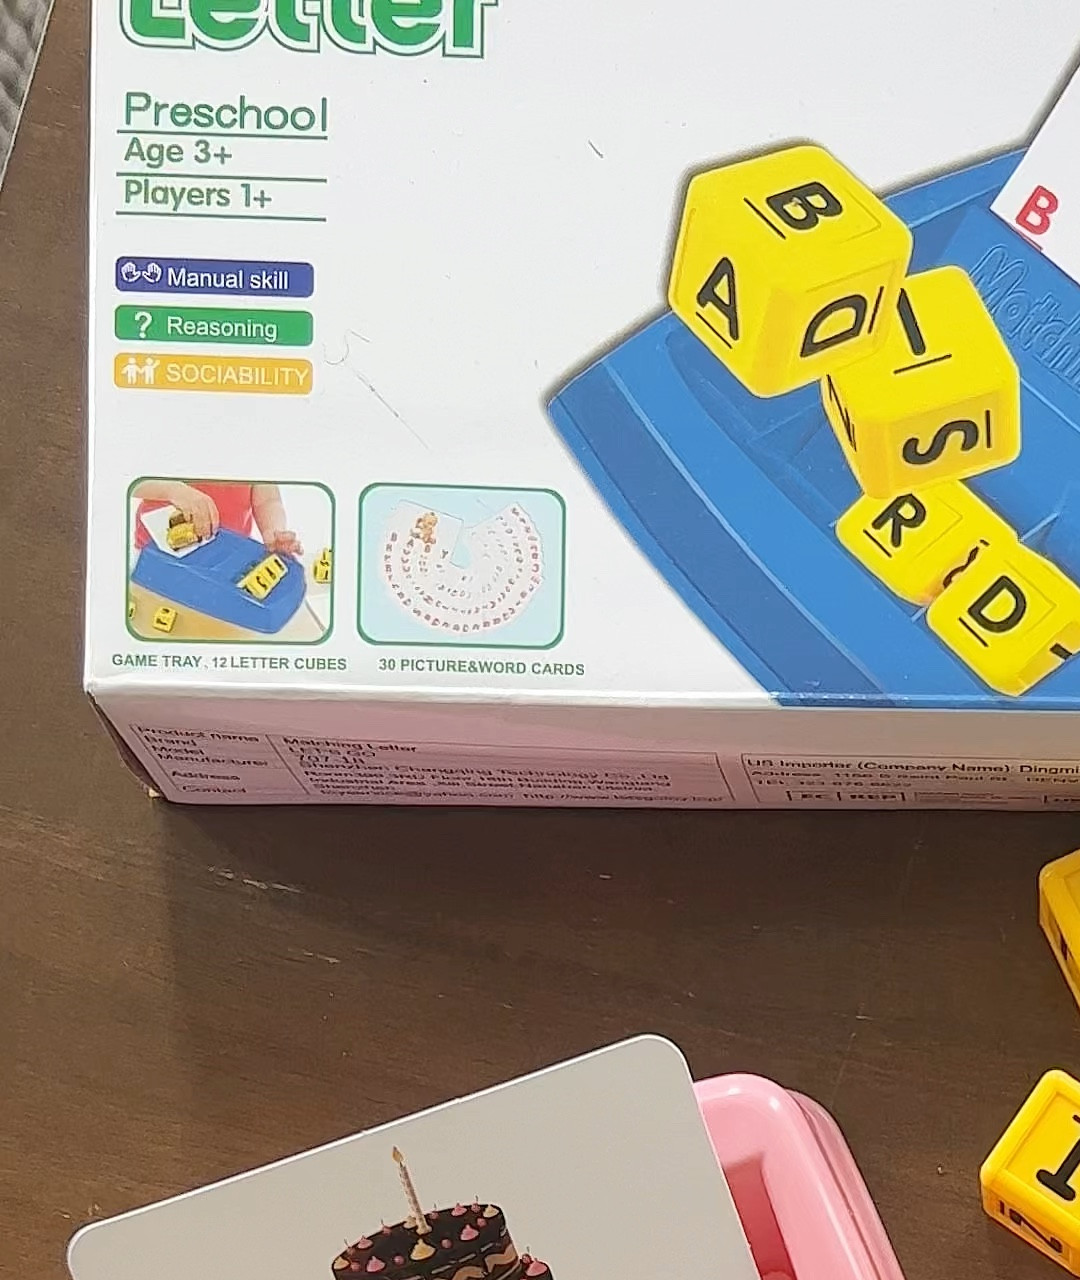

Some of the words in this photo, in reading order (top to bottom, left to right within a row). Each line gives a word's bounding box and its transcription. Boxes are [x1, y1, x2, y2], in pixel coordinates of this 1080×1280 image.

[125, 92, 327, 131] Preschool
[124, 137, 184, 168] Age
[194, 139, 232, 165] 3+
[125, 179, 231, 211] Players
[240, 183, 272, 208] 1+
[766, 181, 843, 231] B
[168, 267, 244, 289] Manual
[250, 270, 289, 290] skill
[697, 257, 740, 340] A
[167, 316, 278, 342] Reasoning
[800, 294, 867, 357] D
[166, 363, 309, 386] SOCIABILITY
[872, 493, 927, 547] R
[967, 575, 1026, 633] D
[112, 654, 157, 667] GAME
[212, 657, 227, 668] 12
[231, 657, 290, 670] LETTER
[294, 658, 348, 671] CUBES
[378, 658, 396, 670] 30
[401, 659, 527, 674] PICTURE&WORD
[531, 662, 586, 676] CARDS
